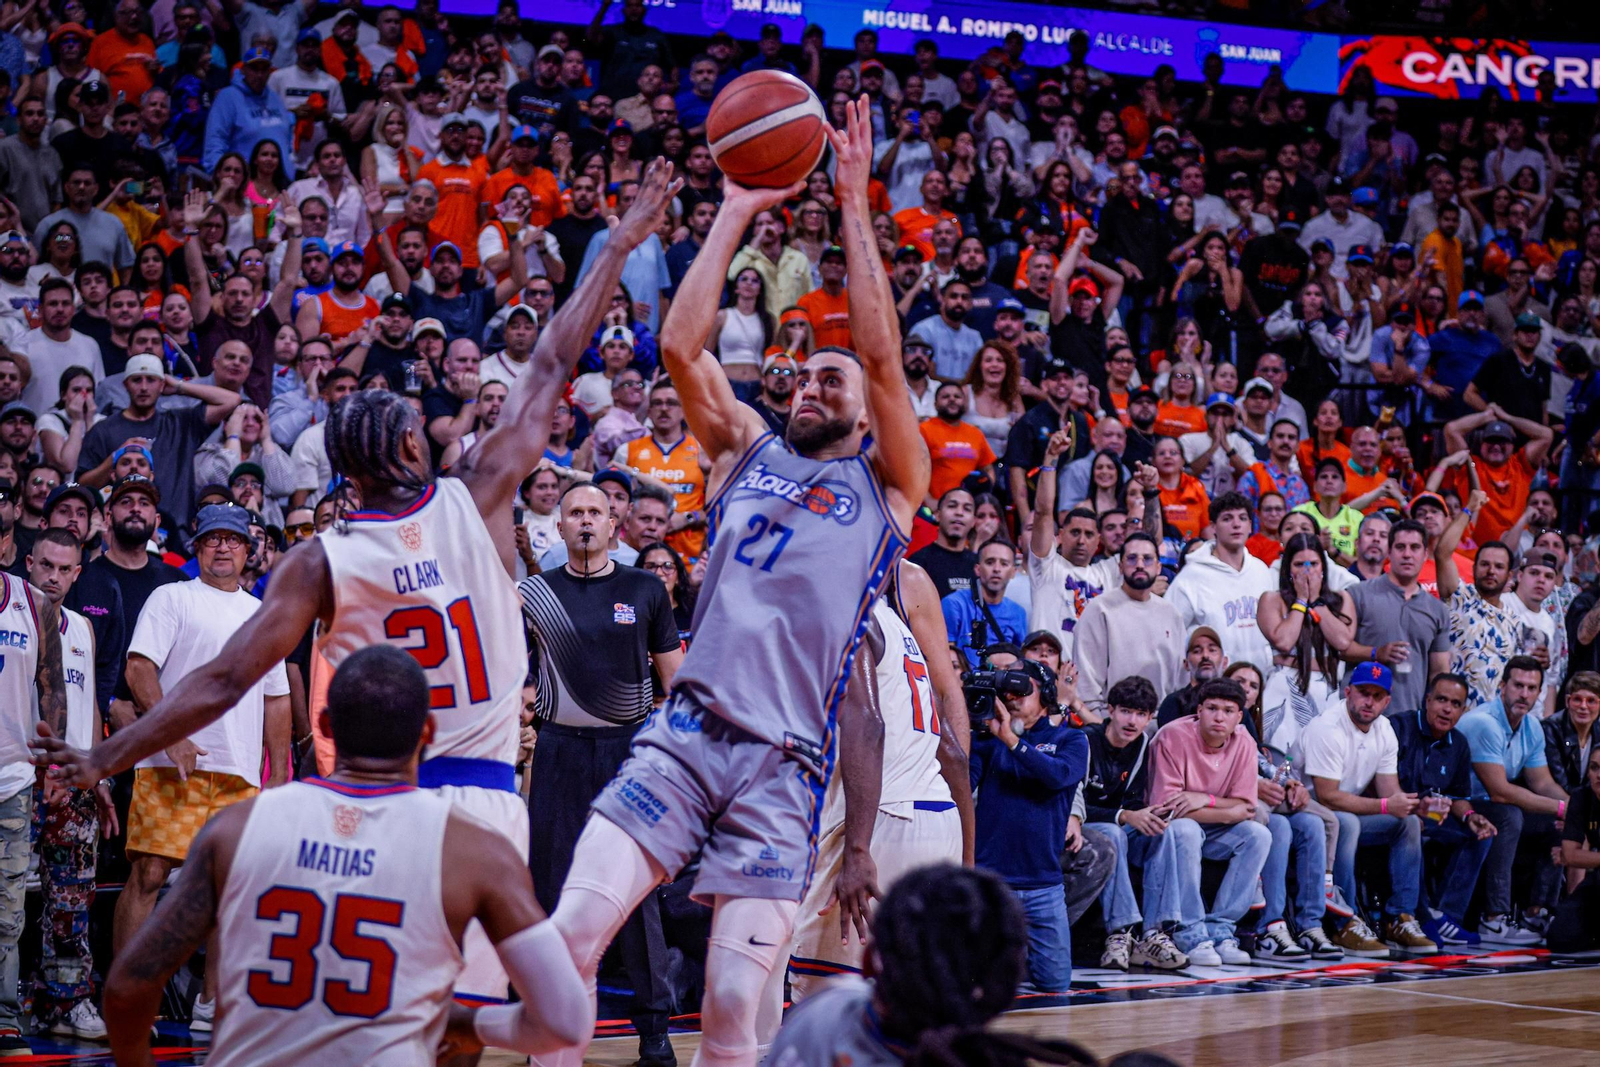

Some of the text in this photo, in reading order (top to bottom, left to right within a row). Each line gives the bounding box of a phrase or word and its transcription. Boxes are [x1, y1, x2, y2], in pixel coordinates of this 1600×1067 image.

[863, 9, 932, 32] MIGUEL
[937, 15, 957, 34] A.
[1094, 32, 1174, 56] ALCALDE
[1219, 43, 1281, 62] SAN JUAN
[734, 513, 794, 573] 27
[393, 559, 444, 594] CLARK
[383, 595, 492, 710] 21
[626, 776, 669, 814] Lomas
[297, 838, 377, 877] MATIAS
[742, 863, 795, 881] Liberty
[246, 883, 405, 1020] 35
